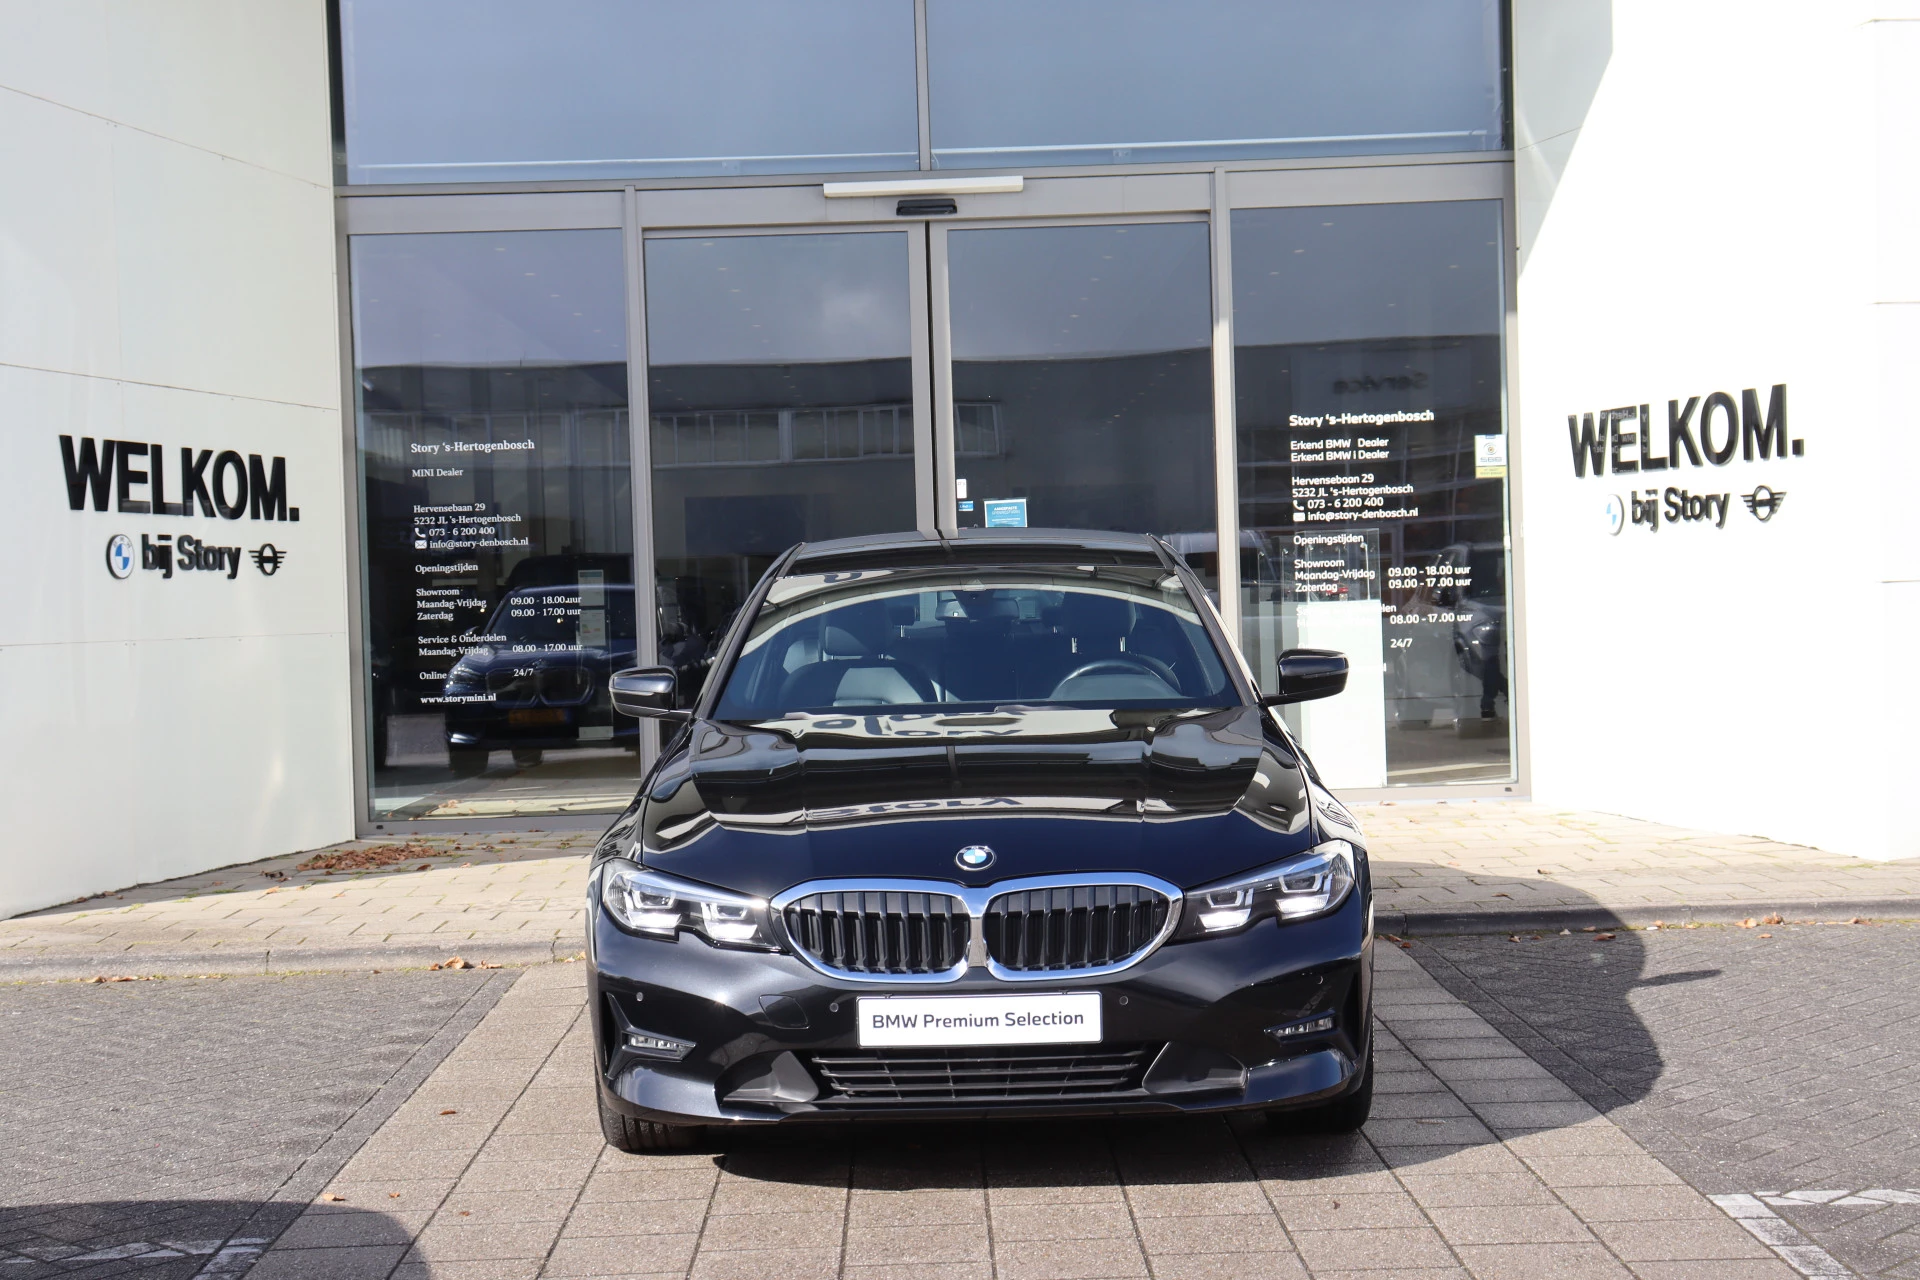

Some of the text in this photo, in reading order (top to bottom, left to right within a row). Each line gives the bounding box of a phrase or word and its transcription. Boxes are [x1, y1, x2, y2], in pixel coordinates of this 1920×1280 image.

[1289, 414, 1323, 428] Story
[1568, 383, 1804, 478] WELKOM.
[411, 443, 439, 455] Story
[1290, 437, 1389, 450] Erkend BMW Dealer
[1290, 450, 1389, 462] Erkend BMW i Dealer
[59, 434, 299, 522] WELKOM.
[412, 468, 463, 477] MINI Dealer
[1292, 473, 1375, 486] Hervensebaan 29
[1292, 488, 1316, 497] 5232
[1317, 487, 1328, 497] JL
[413, 503, 486, 513] Hervensebaan 29
[1307, 499, 1326, 509] 073
[1334, 498, 1341, 508] 6
[1342, 498, 1362, 507] 200
[1364, 497, 1384, 507] 400
[1307, 507, 1419, 522] info@story-denbosch.nl
[1631, 486, 1730, 533] bij Story
[414, 517, 435, 525] 5232
[437, 516, 448, 524] JL
[429, 528, 445, 536] 073
[453, 527, 458, 535] 6
[461, 527, 476, 535] 200
[479, 527, 495, 535] 400
[429, 537, 529, 550] info@story-denbosch.nl
[1293, 534, 1364, 546] Openingstijden
[141, 533, 241, 579] bij Story
[415, 563, 478, 574] Openingstijden
[1294, 559, 1345, 569] Showroom
[1295, 569, 1375, 581] Maandag-Vrijdag
[1388, 567, 1417, 577] 09.00
[1425, 566, 1452, 575] 18.00
[1454, 566, 1471, 575] uur
[1295, 582, 1338, 593] Zaterdag
[1388, 579, 1418, 589] 09.00
[1426, 578, 1453, 587] 17.00
[1455, 578, 1472, 587] uur
[416, 588, 460, 596] Showroom
[417, 599, 487, 610] Maandag-Vrijdag
[511, 597, 534, 605] 09.00
[417, 612, 454, 621] Zaterdag
[511, 609, 535, 617] 09.00
[543, 608, 565, 616] 17.00
[1390, 615, 1419, 624] 08.00
[1428, 613, 1455, 623] 17.00
[1457, 613, 1473, 622] uur
[418, 636, 449, 644] Service
[459, 634, 507, 643] Onderdelen
[1390, 638, 1413, 648] 24/7
[419, 647, 489, 657] Maandag-Vrijdag
[512, 645, 536, 653] 08.00
[544, 644, 566, 652] 17.00
[420, 668, 534, 680] Online 24/7
[420, 694, 496, 705] www.storymini.nl
[872, 1011, 1084, 1029] BMW Premium Selection
